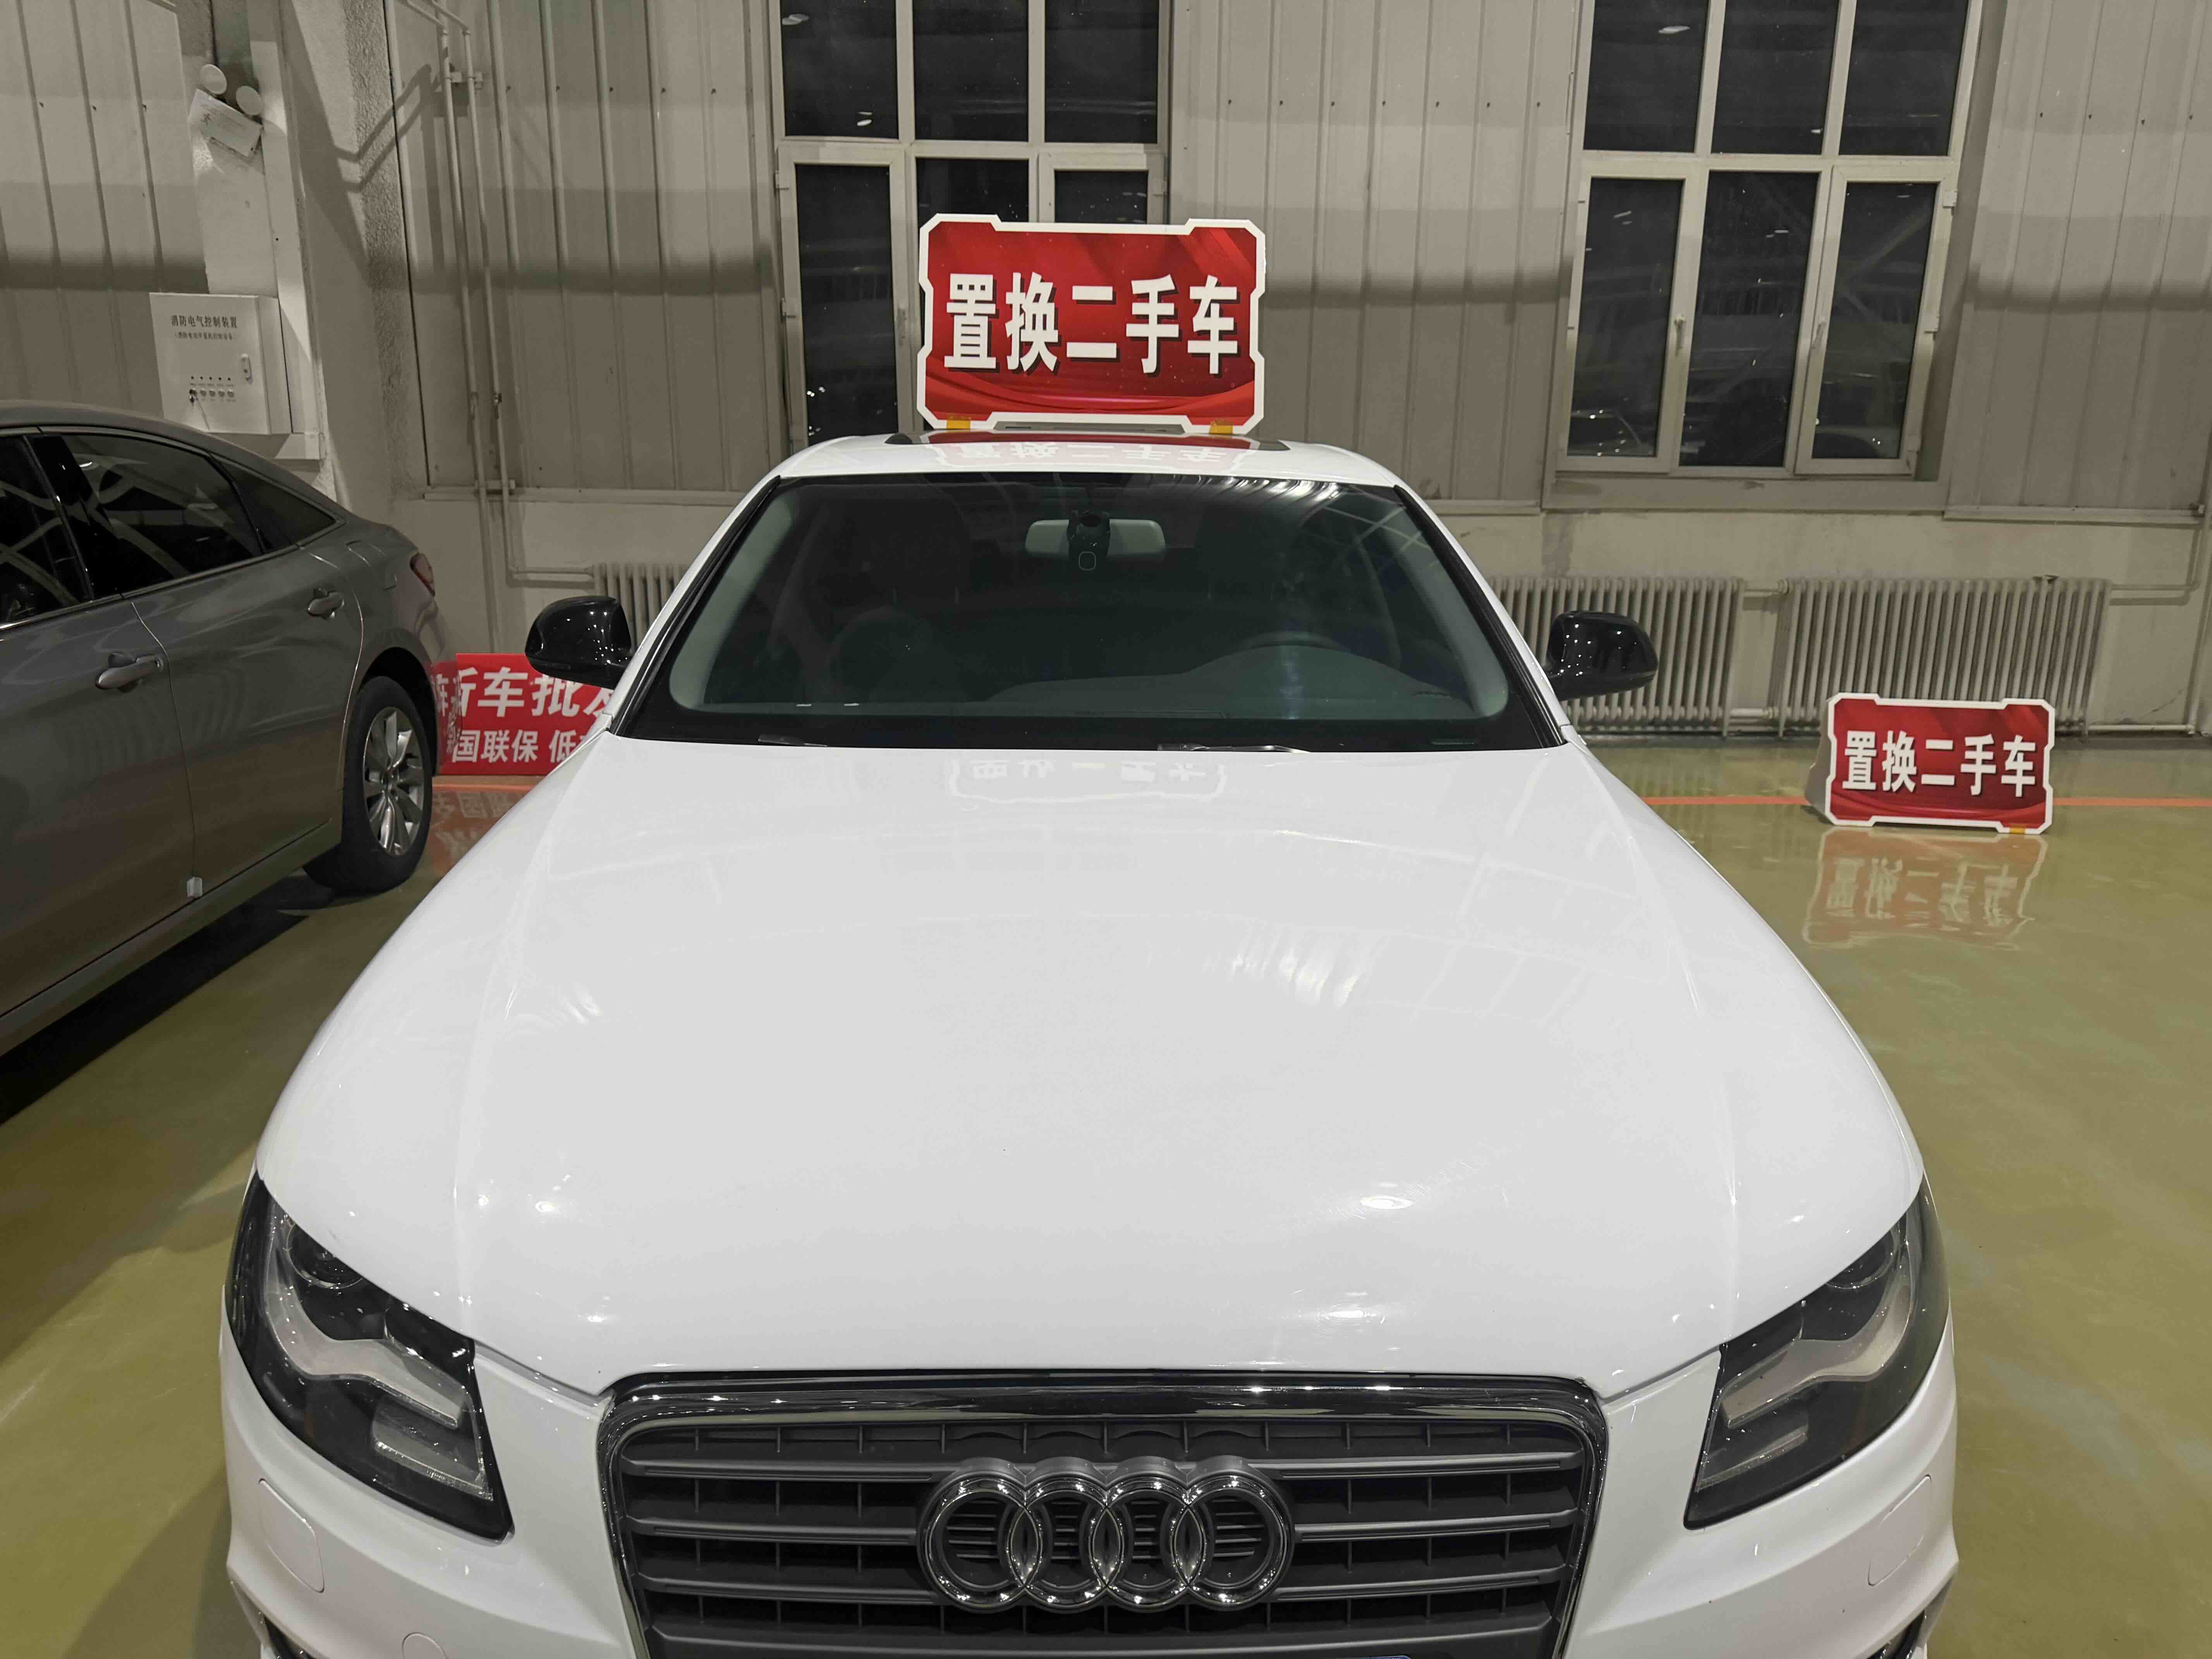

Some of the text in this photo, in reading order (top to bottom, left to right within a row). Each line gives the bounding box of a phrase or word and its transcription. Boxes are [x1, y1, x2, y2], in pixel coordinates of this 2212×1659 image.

[944, 271, 1238, 374] 置换二手车
[548, 730, 585, 763] 低
[1842, 730, 2036, 797] 置换二手车
